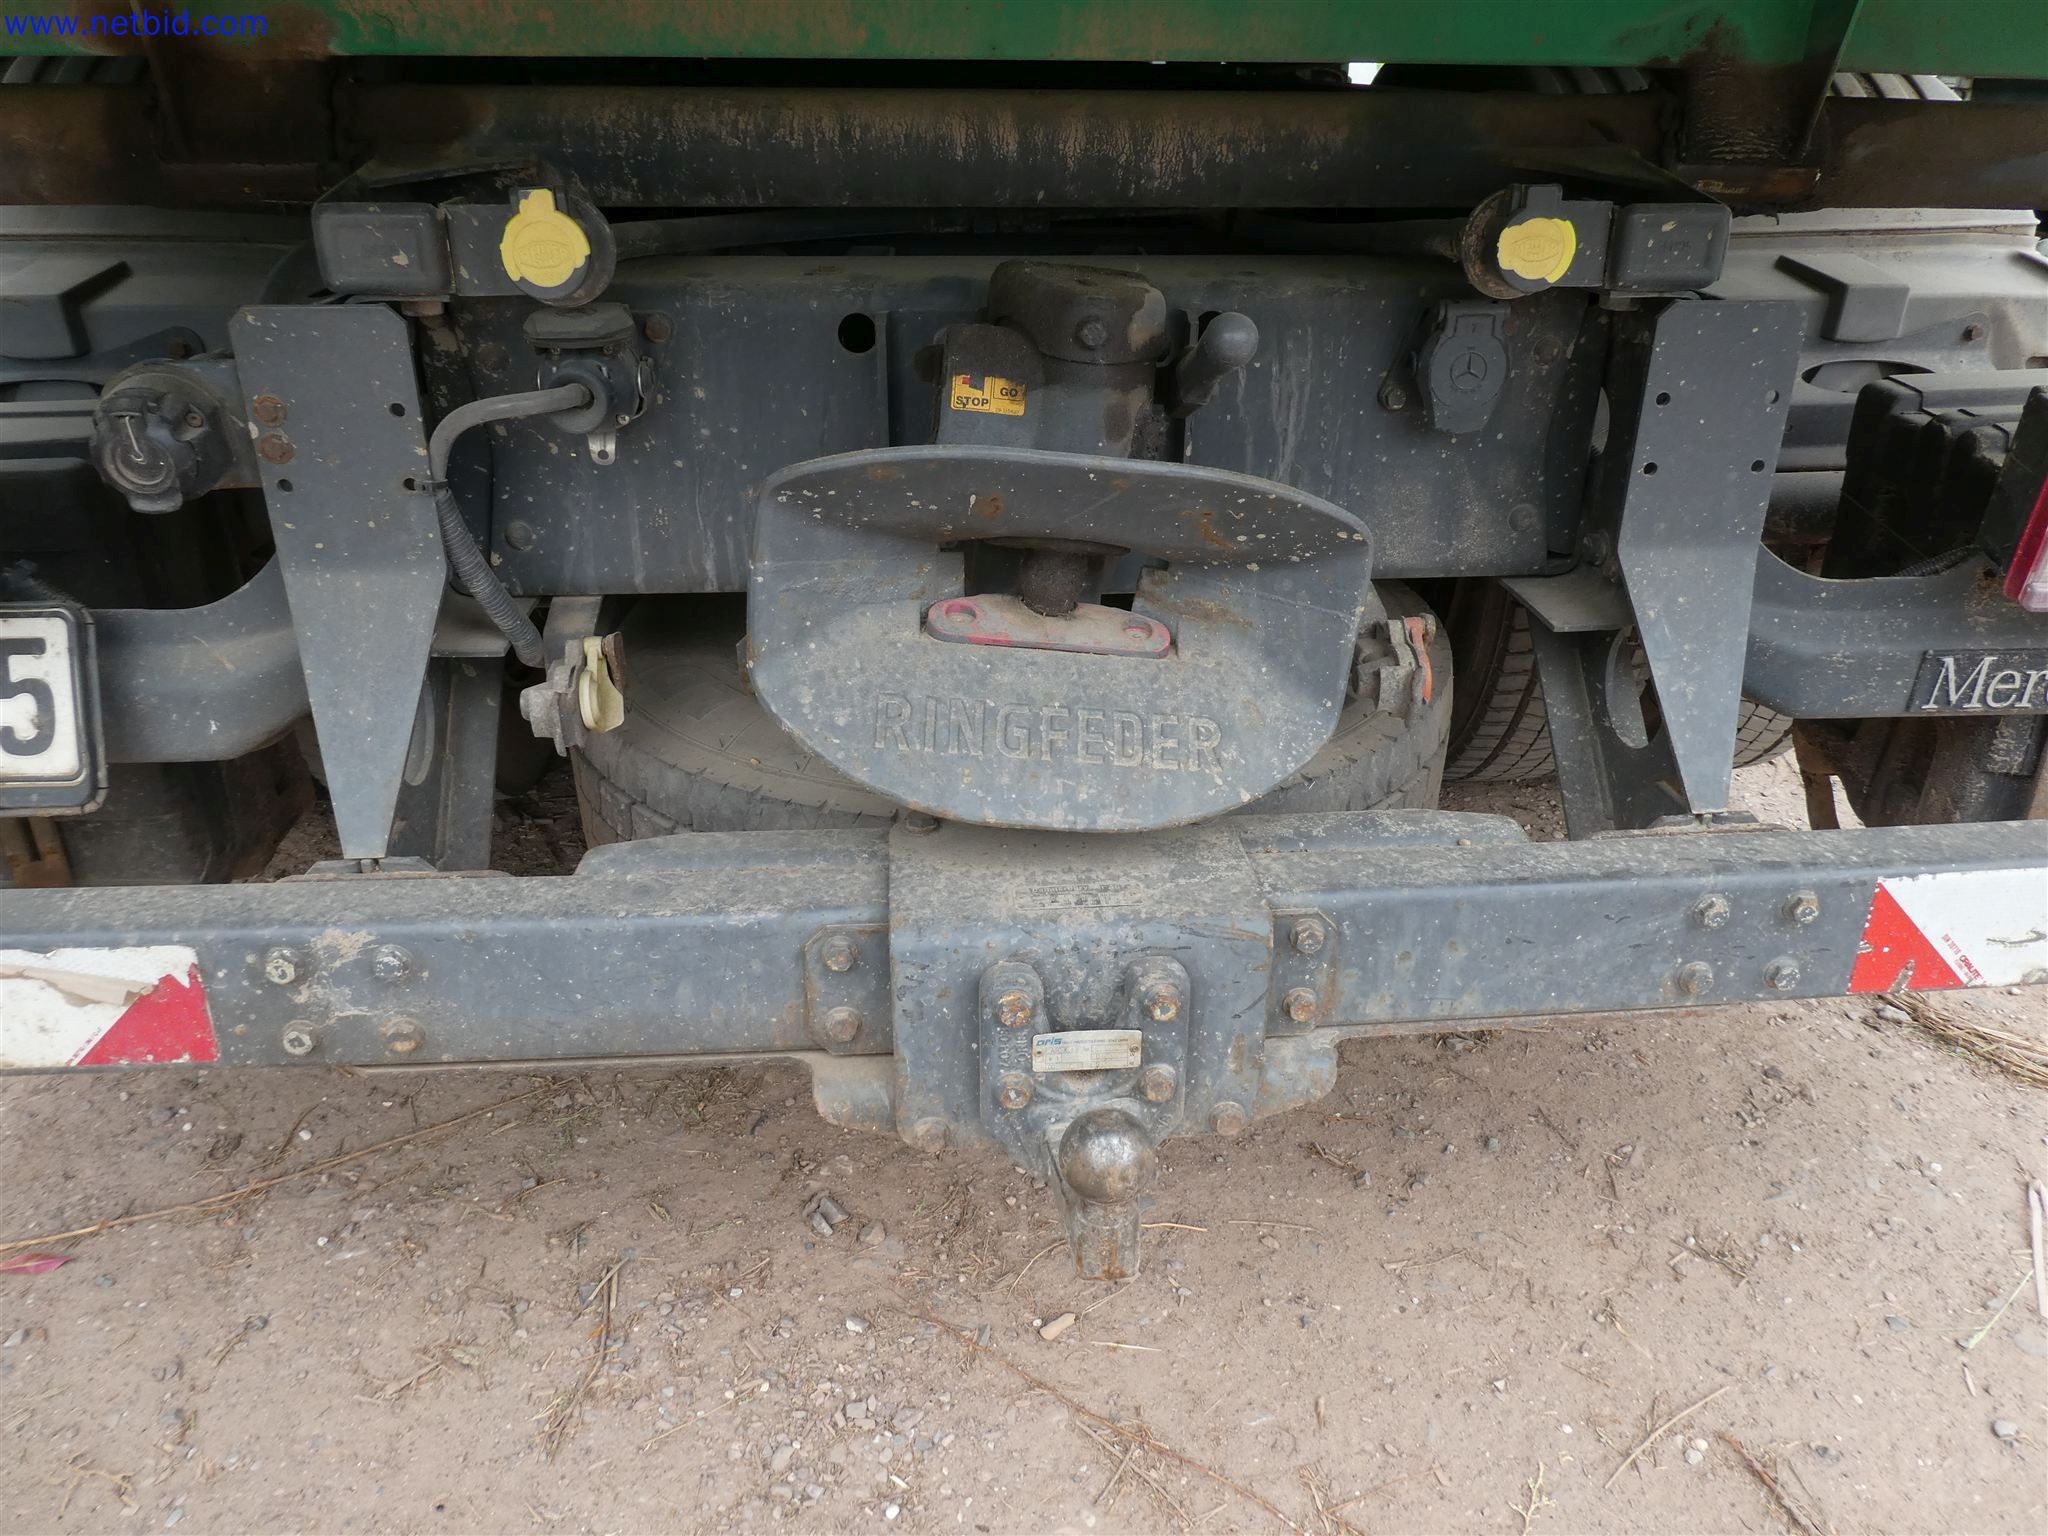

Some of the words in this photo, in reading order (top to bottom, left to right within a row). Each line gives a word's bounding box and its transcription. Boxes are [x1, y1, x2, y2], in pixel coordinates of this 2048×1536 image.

[1000, 387, 1018, 398] GO
[955, 395, 989, 407] STOP
[874, 692, 1223, 774] RINGFEDER
[1036, 1037, 1062, 1046] oris
